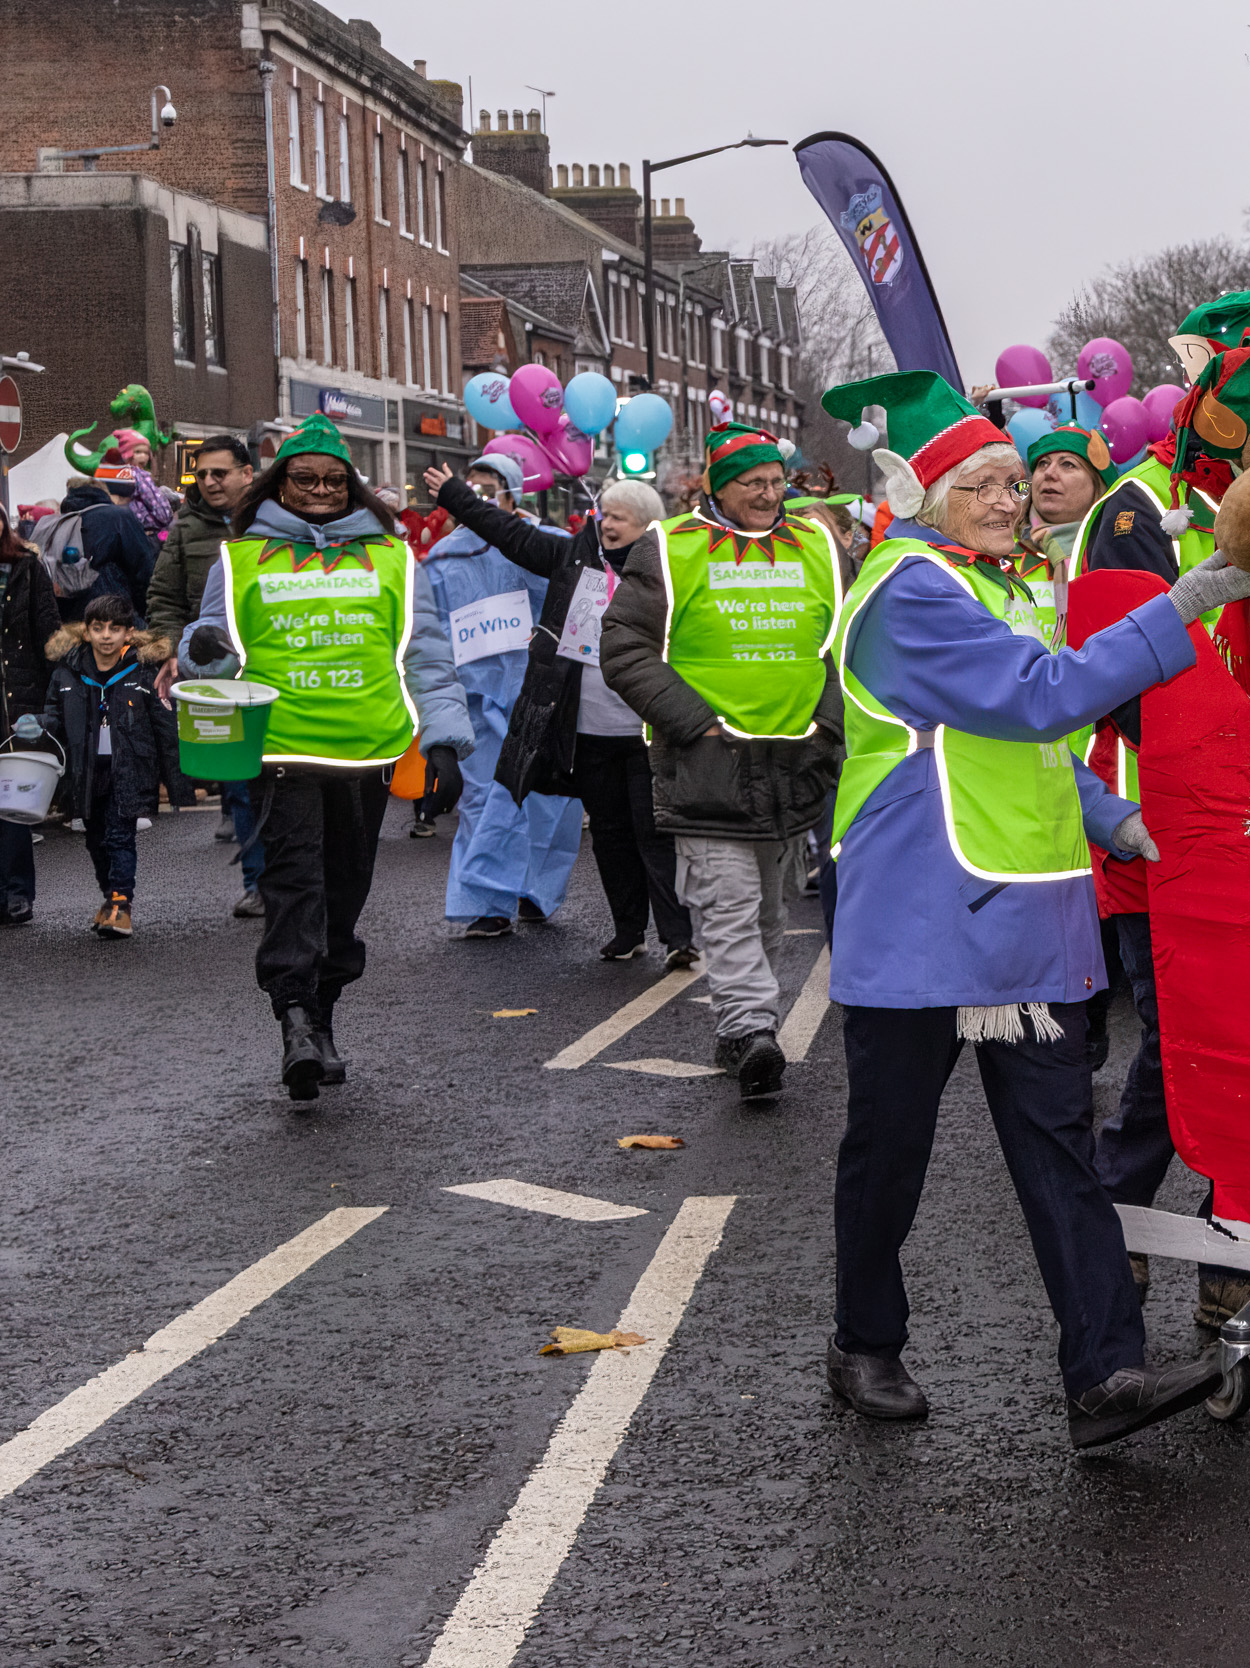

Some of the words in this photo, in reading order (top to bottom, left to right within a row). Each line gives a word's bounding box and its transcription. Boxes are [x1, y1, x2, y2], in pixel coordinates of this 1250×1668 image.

[713, 569, 800, 581] SAMARITANS
[264, 576, 373, 594] SAMARITANS
[715, 598, 767, 614] We're
[770, 598, 805, 612] here
[269, 611, 330, 630] We're
[334, 609, 375, 626] here
[729, 617, 749, 631] to
[752, 616, 797, 630] listen
[458, 628, 476, 643] Dr
[479, 616, 521, 635] Who
[285, 634, 307, 648] to
[311, 630, 364, 647] listen
[287, 670, 321, 689] 116
[326, 669, 364, 688] 123
